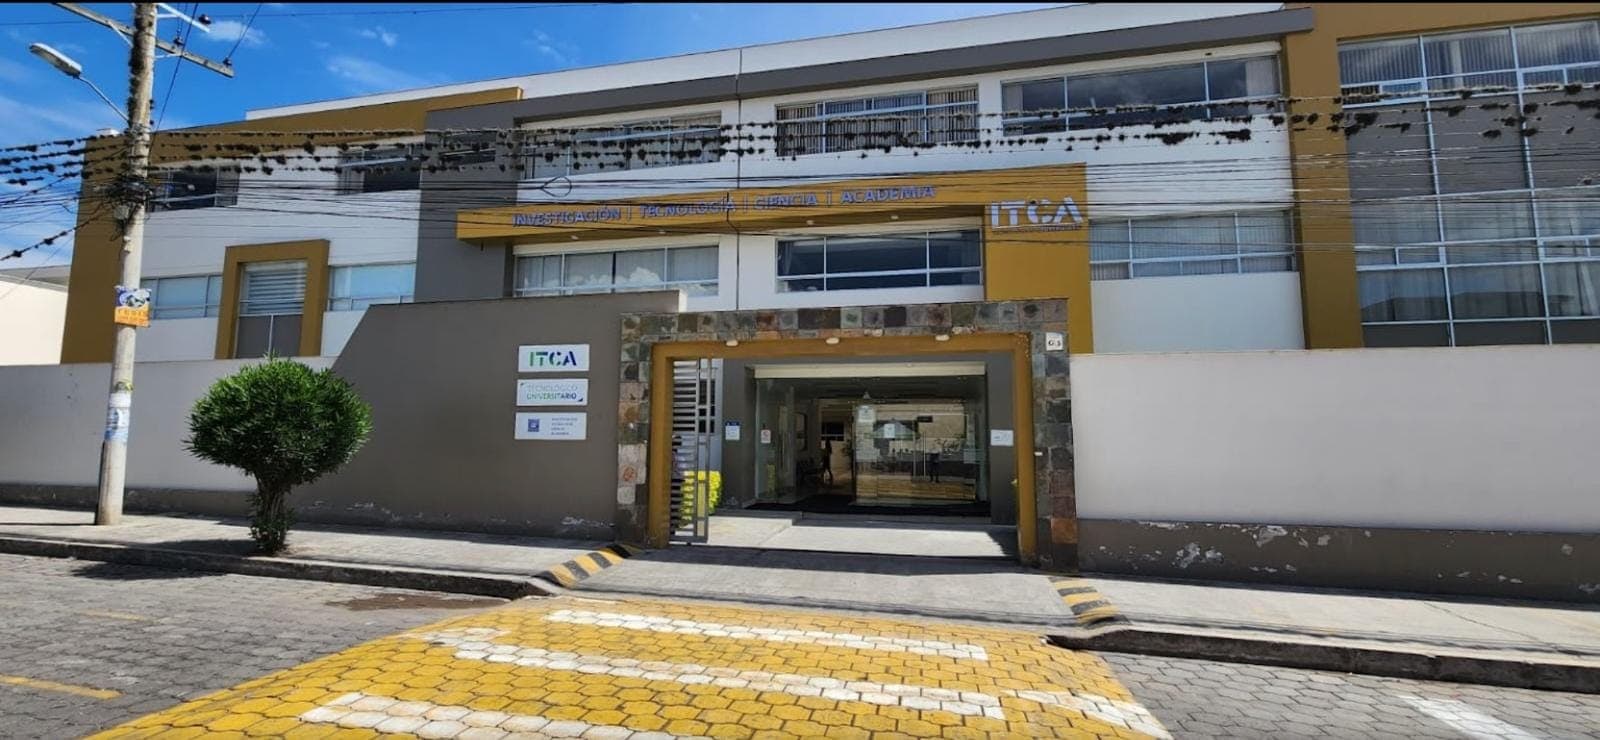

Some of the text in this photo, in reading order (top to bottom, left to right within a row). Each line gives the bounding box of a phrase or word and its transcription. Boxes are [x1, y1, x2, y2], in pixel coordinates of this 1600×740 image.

[754, 192, 817, 211] CIENCIA
[841, 186, 936, 204] ACADEMIA
[991, 197, 1084, 226] ITCA
[530, 351, 577, 367] ITCA
